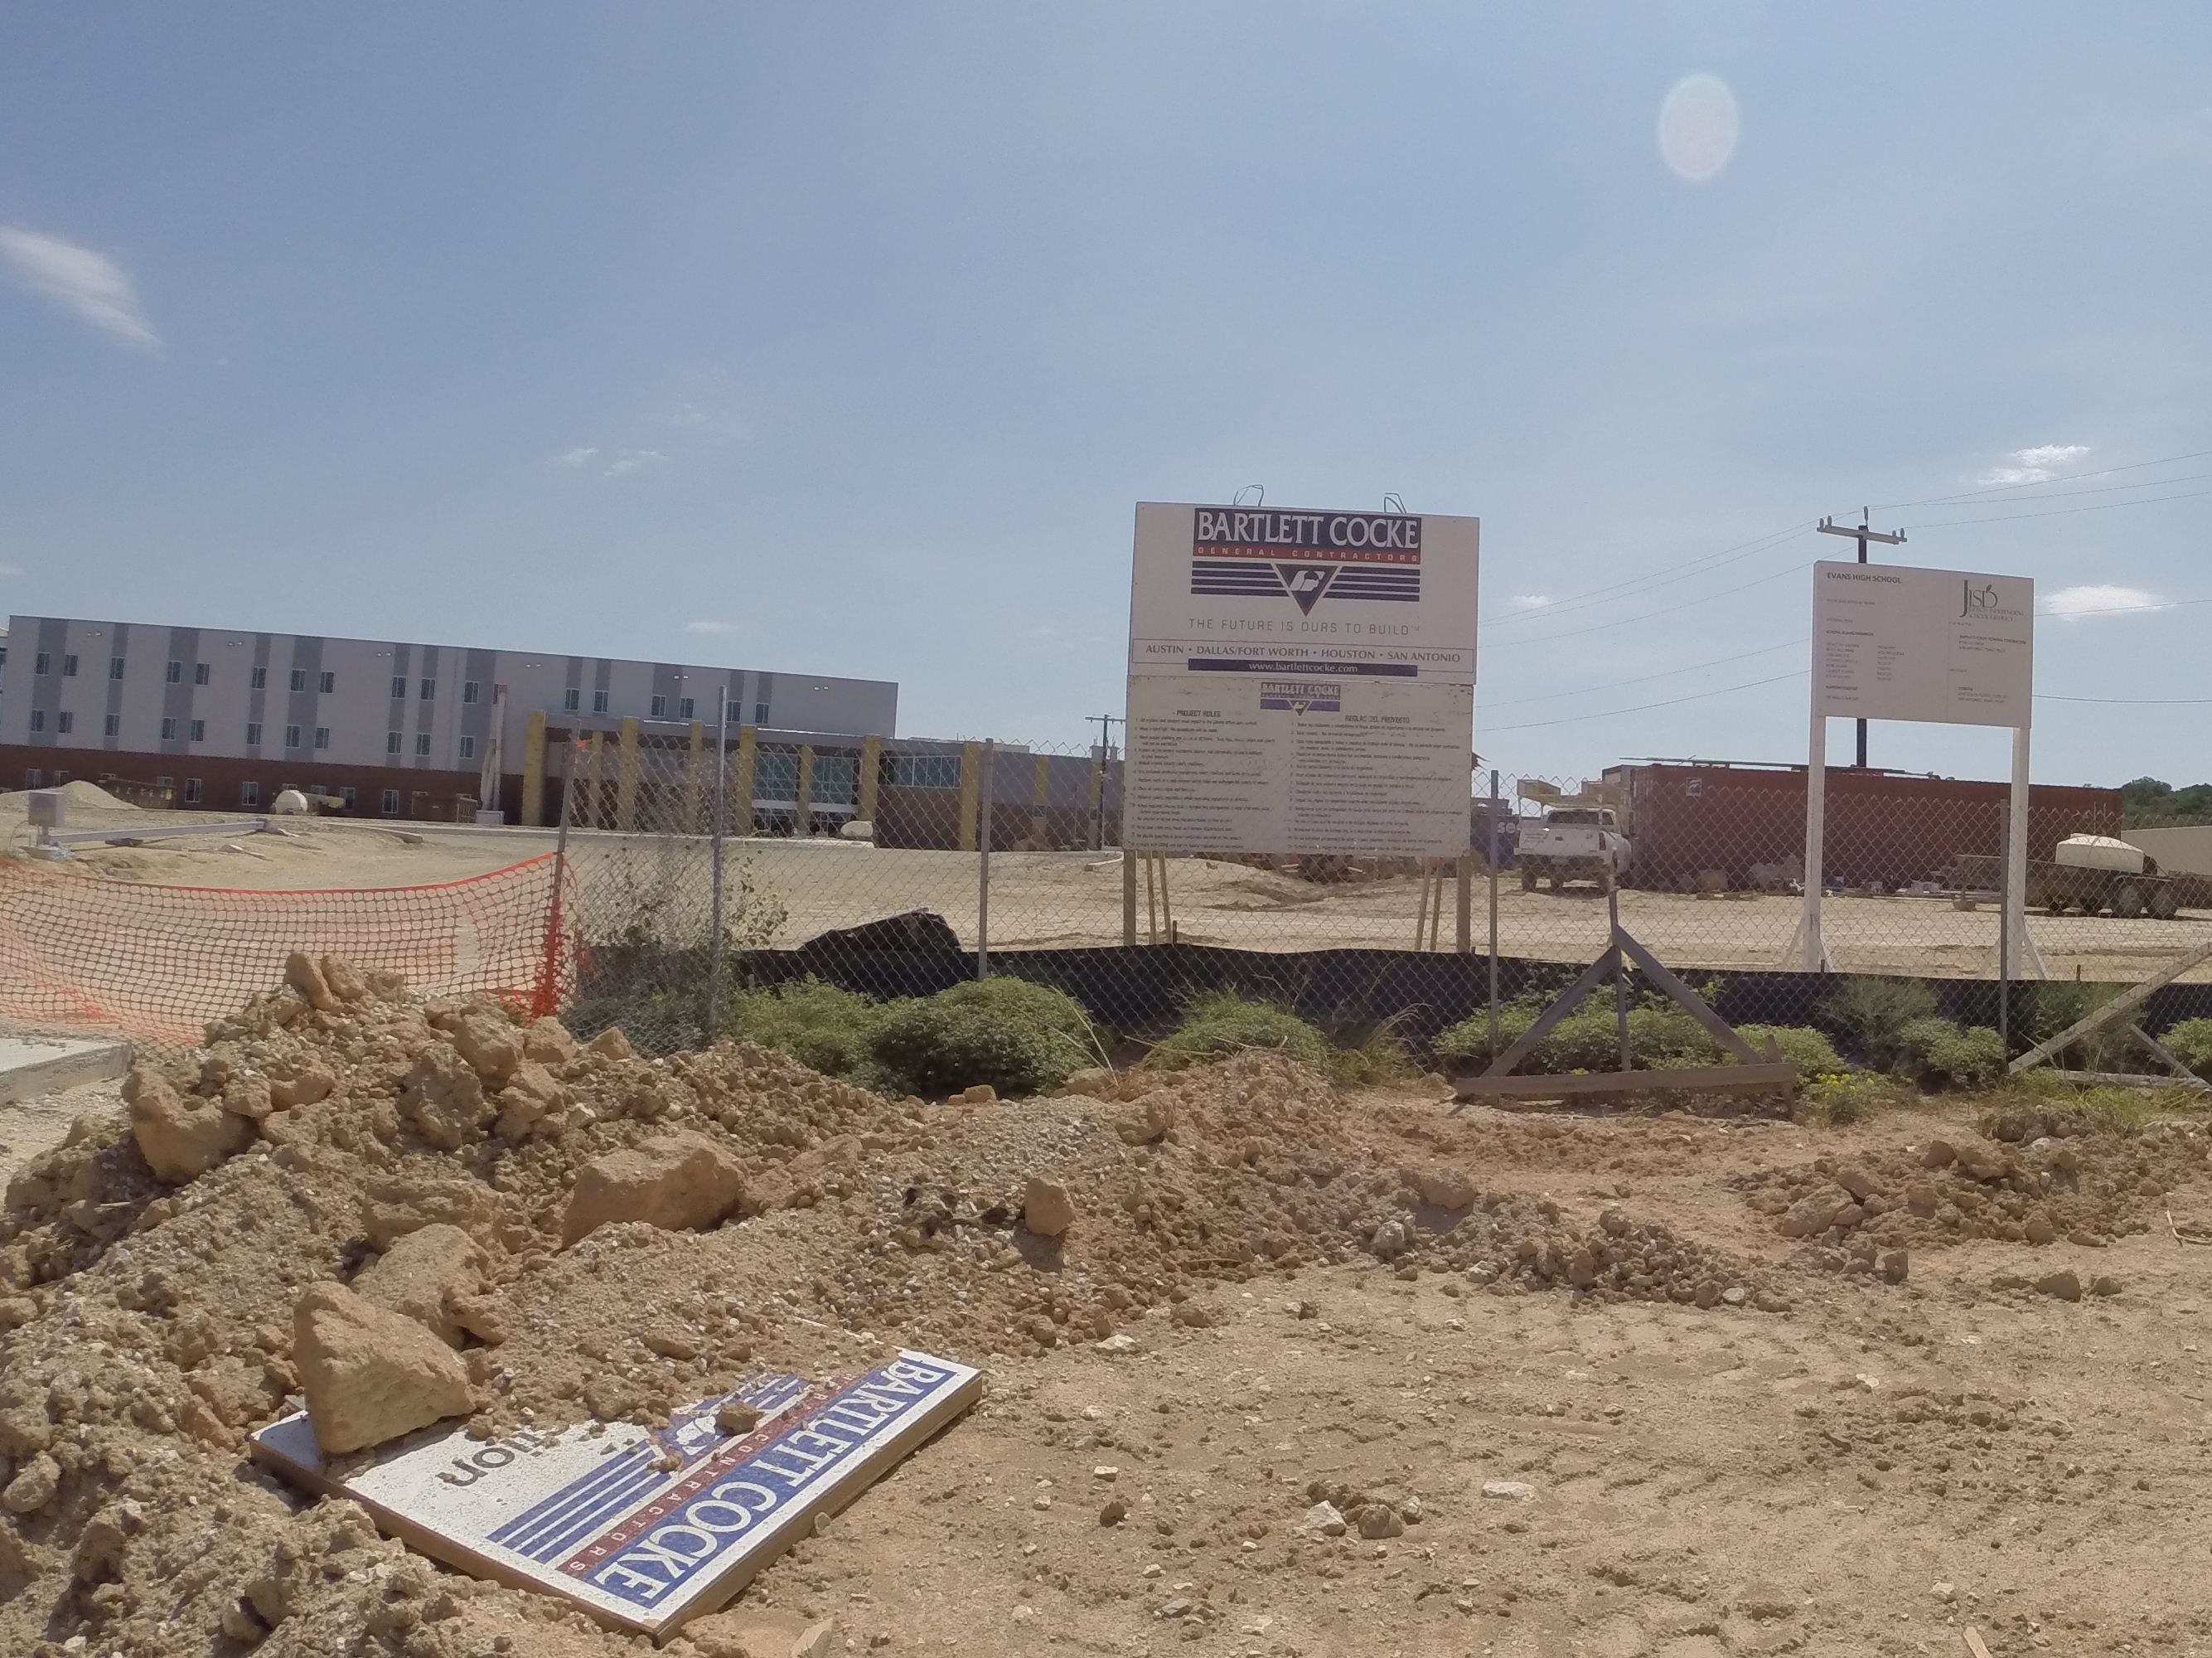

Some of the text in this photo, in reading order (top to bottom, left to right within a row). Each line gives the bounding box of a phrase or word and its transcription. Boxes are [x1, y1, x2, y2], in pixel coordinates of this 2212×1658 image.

[1198, 511, 1419, 549] BARTLETT COCKE
[1198, 546, 1416, 562] GENERAL CONTRACTORS
[1827, 571, 1902, 584] EVANS HIGH SCHOOL
[1189, 618, 1213, 629] THE
[1221, 619, 1273, 631] FUTURE
[1280, 621, 1294, 632] IS
[1301, 621, 1338, 633] OURS
[1345, 623, 1361, 634] TO
[1145, 644, 1461, 662] AUSTIN DALLAS/FORT WORTH HOUSTON SAN ANTONIO
[1248, 662, 1358, 673] www.bartlettcocke.com
[1262, 683, 1304, 695] BARTLETT
[1307, 685, 1340, 696] COCKE
[750, 1360, 946, 1487] BARTLETT
[569, 1433, 769, 1571] CONTRACTORS
[593, 1481, 777, 1600] COCKE
